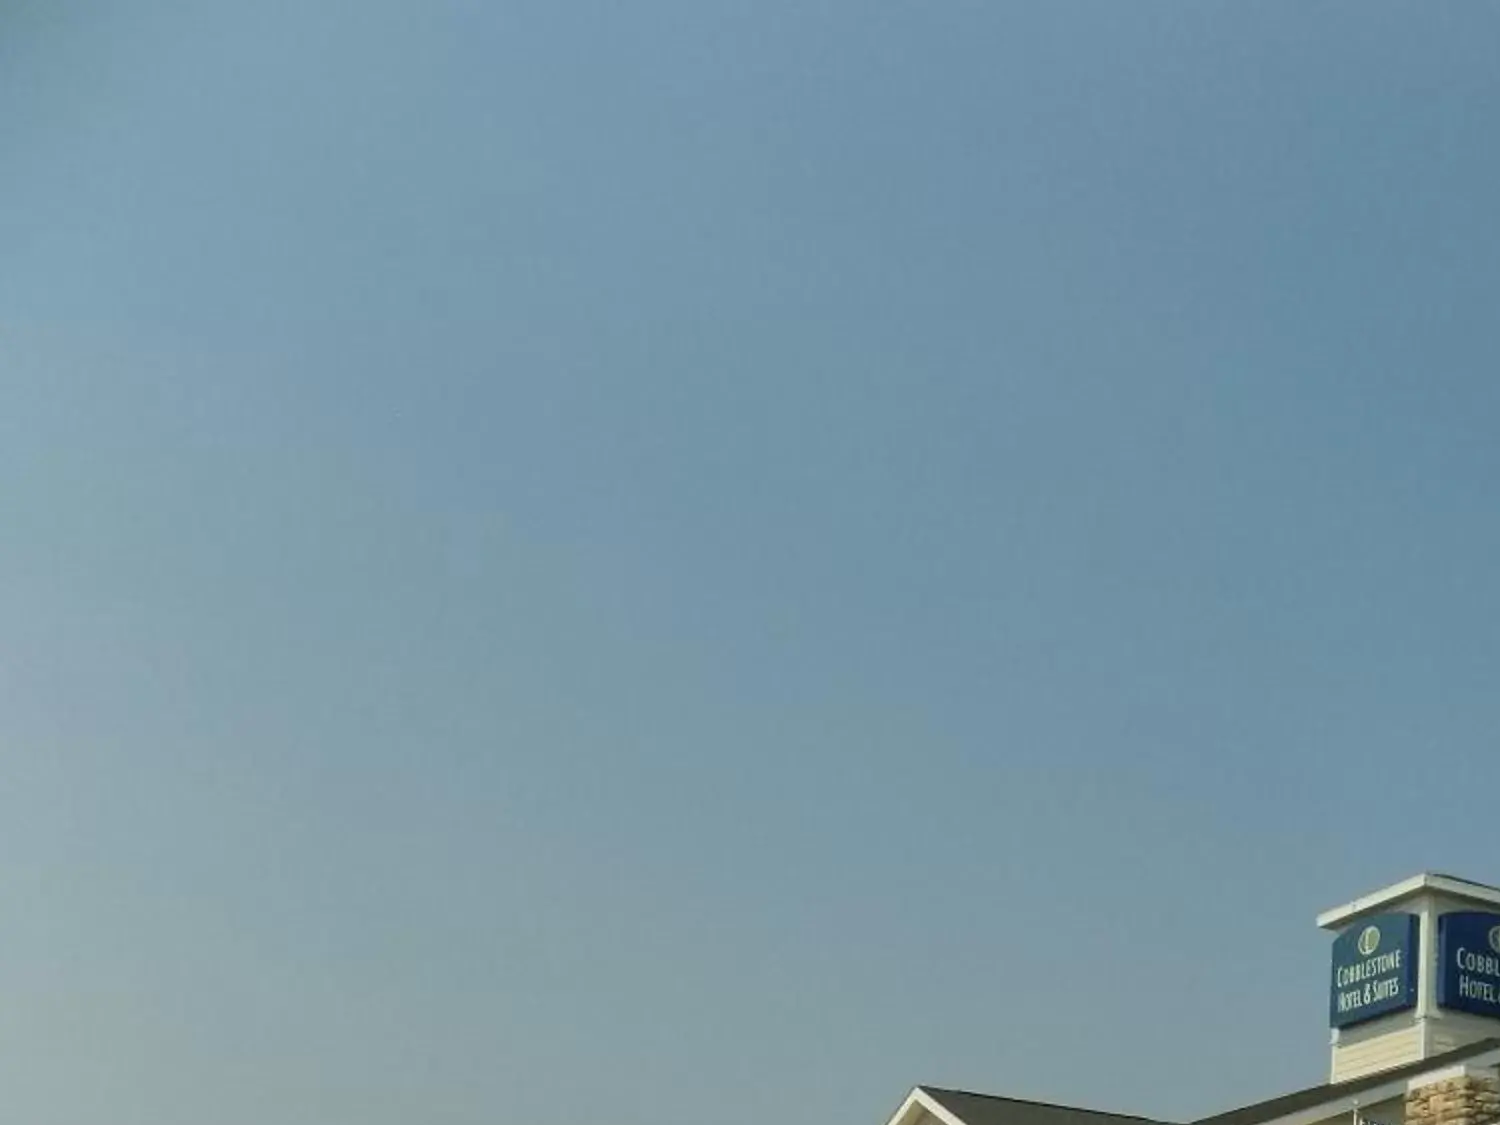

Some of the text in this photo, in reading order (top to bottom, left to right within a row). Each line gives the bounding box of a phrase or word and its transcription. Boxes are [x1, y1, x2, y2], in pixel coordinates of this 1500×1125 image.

[1337, 949, 1401, 988] COBBLESTONE
[1338, 976, 1400, 1012] HOTEL & SUITES
[1459, 975, 1495, 1004] HOTEL
